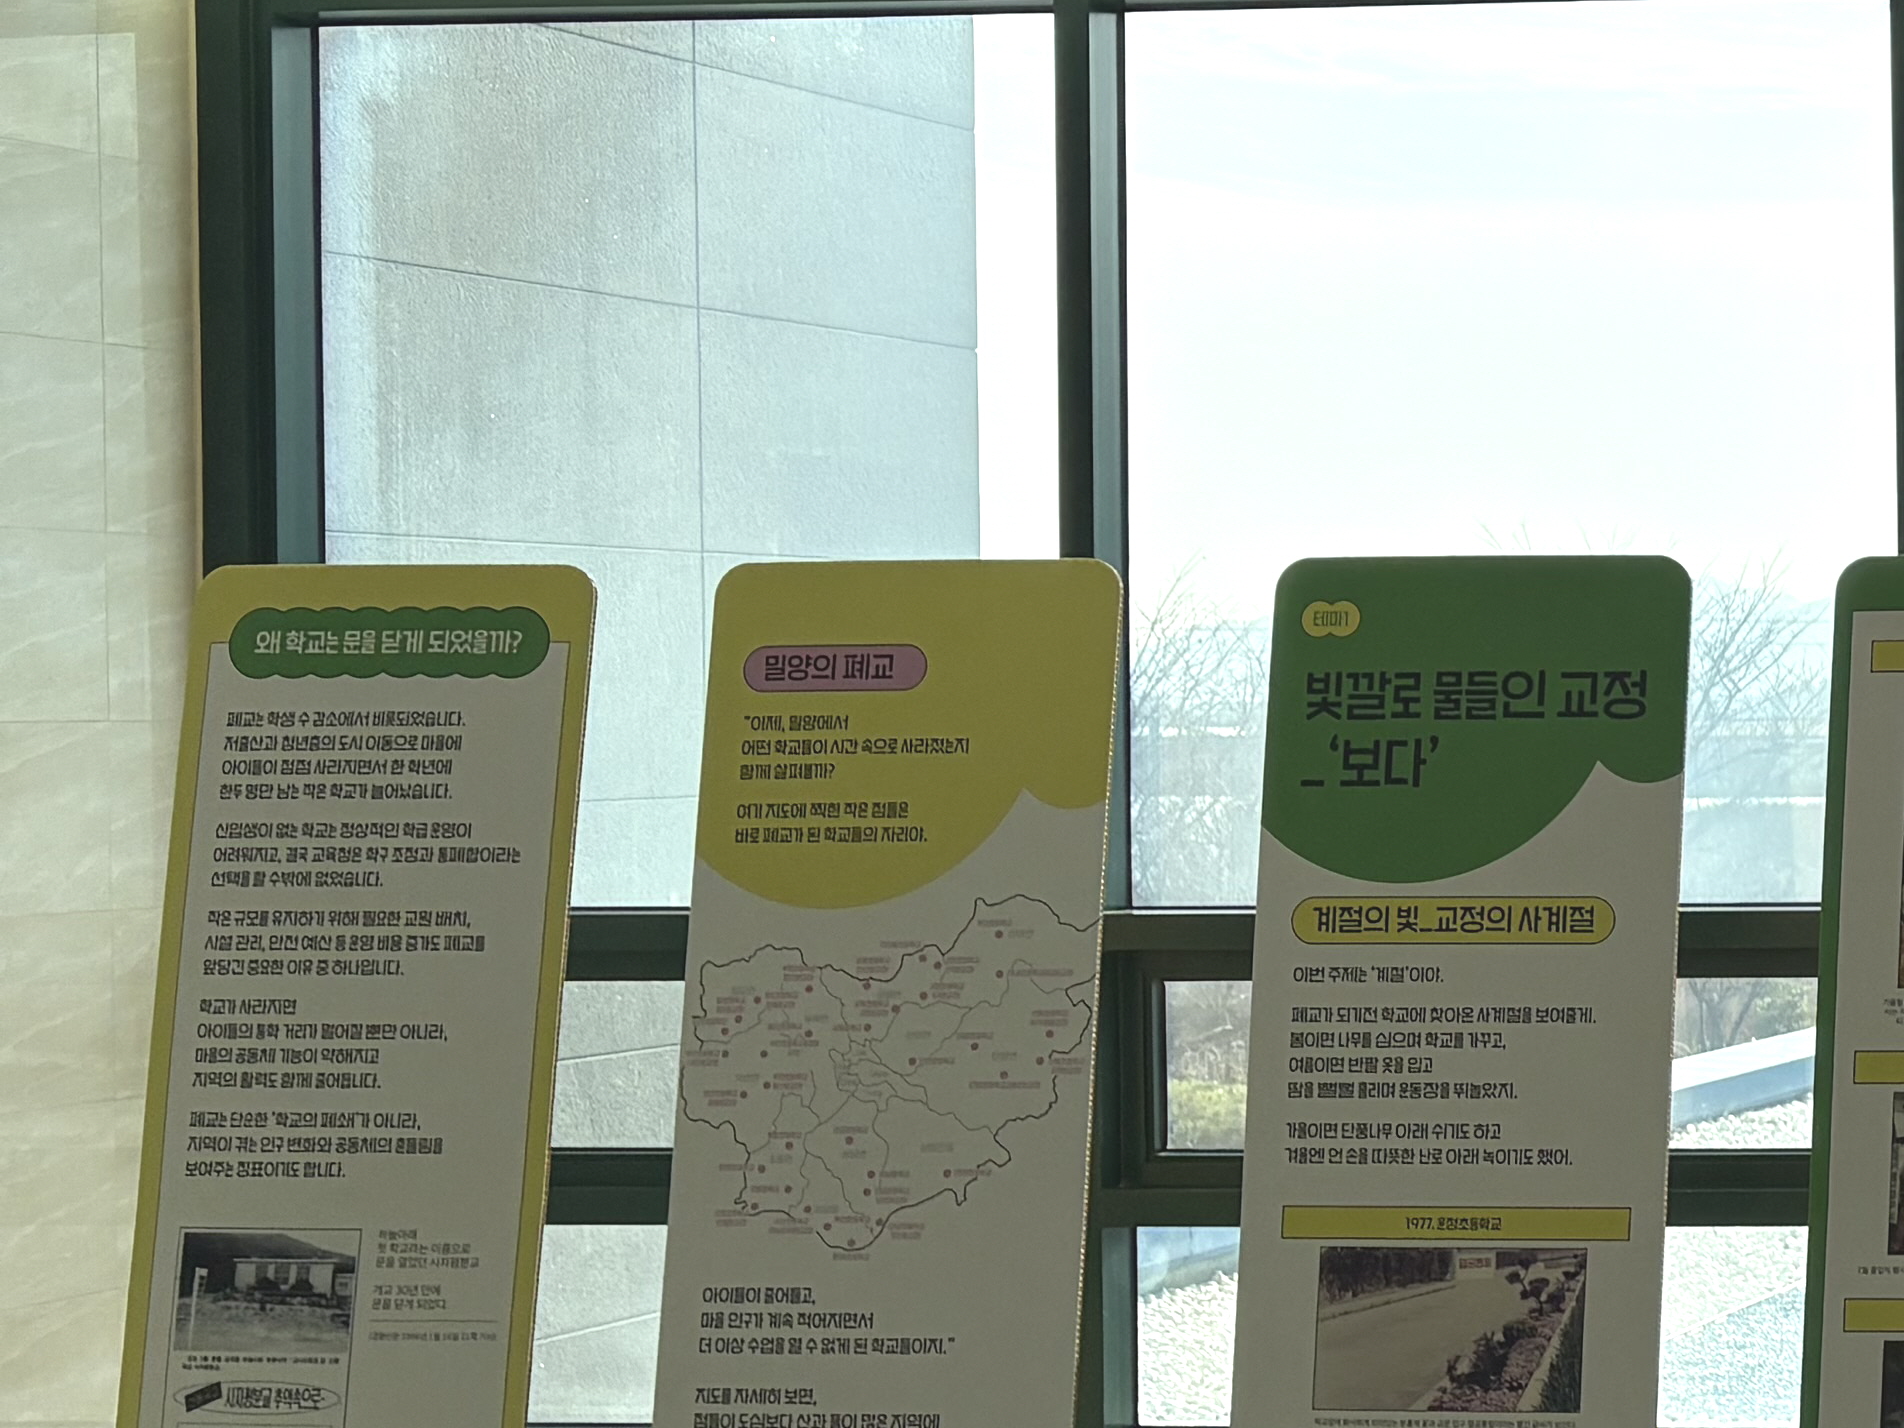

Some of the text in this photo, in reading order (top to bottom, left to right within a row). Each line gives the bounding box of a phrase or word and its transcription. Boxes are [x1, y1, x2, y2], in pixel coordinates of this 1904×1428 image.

[1313, 611, 1348, 627] 테마1
[254, 630, 522, 654] 왜 학교는 문을 닫게 되었을까?
[765, 653, 894, 681] 밀양의 폐교
[1306, 670, 1647, 720] 빛깔로 물들인 교정
[338, 735, 363, 751] 도시
[366, 735, 418, 751] 이동으로
[421, 735, 462, 751] 마을에
[742, 738, 969, 756] 어떤 학교들이 시간 속으로 사라졌는지
[737, 803, 762, 819] 여기
[765, 803, 807, 819] 지도에
[844, 802, 868, 819] 작은
[872, 802, 908, 819] 점들은
[1313, 905, 1389, 933] 계절의
[1518, 905, 1594, 933] 사계절
[1293, 967, 1325, 983] 이번
[1328, 967, 1367, 983] 주제는
[200, 999, 297, 1015] 학교가 사라지면
[1292, 1007, 1596, 1024] 폐교가 되기전 학교에 찾아온 사계절을 보여줄게.
[1290, 1032, 1506, 1049] 봄이면 나무를 심으며 학교를 가꾸고,
[195, 1047, 379, 1064] 마을의 공동체 기능이 약해지고
[1286, 1122, 1500, 1140] 가을이면 단풍나무 아래 쉬기도 하고
[185, 1161, 234, 1177] 보여주는
[701, 1311, 873, 1329] 마을 인구가 계속 적어지면서
